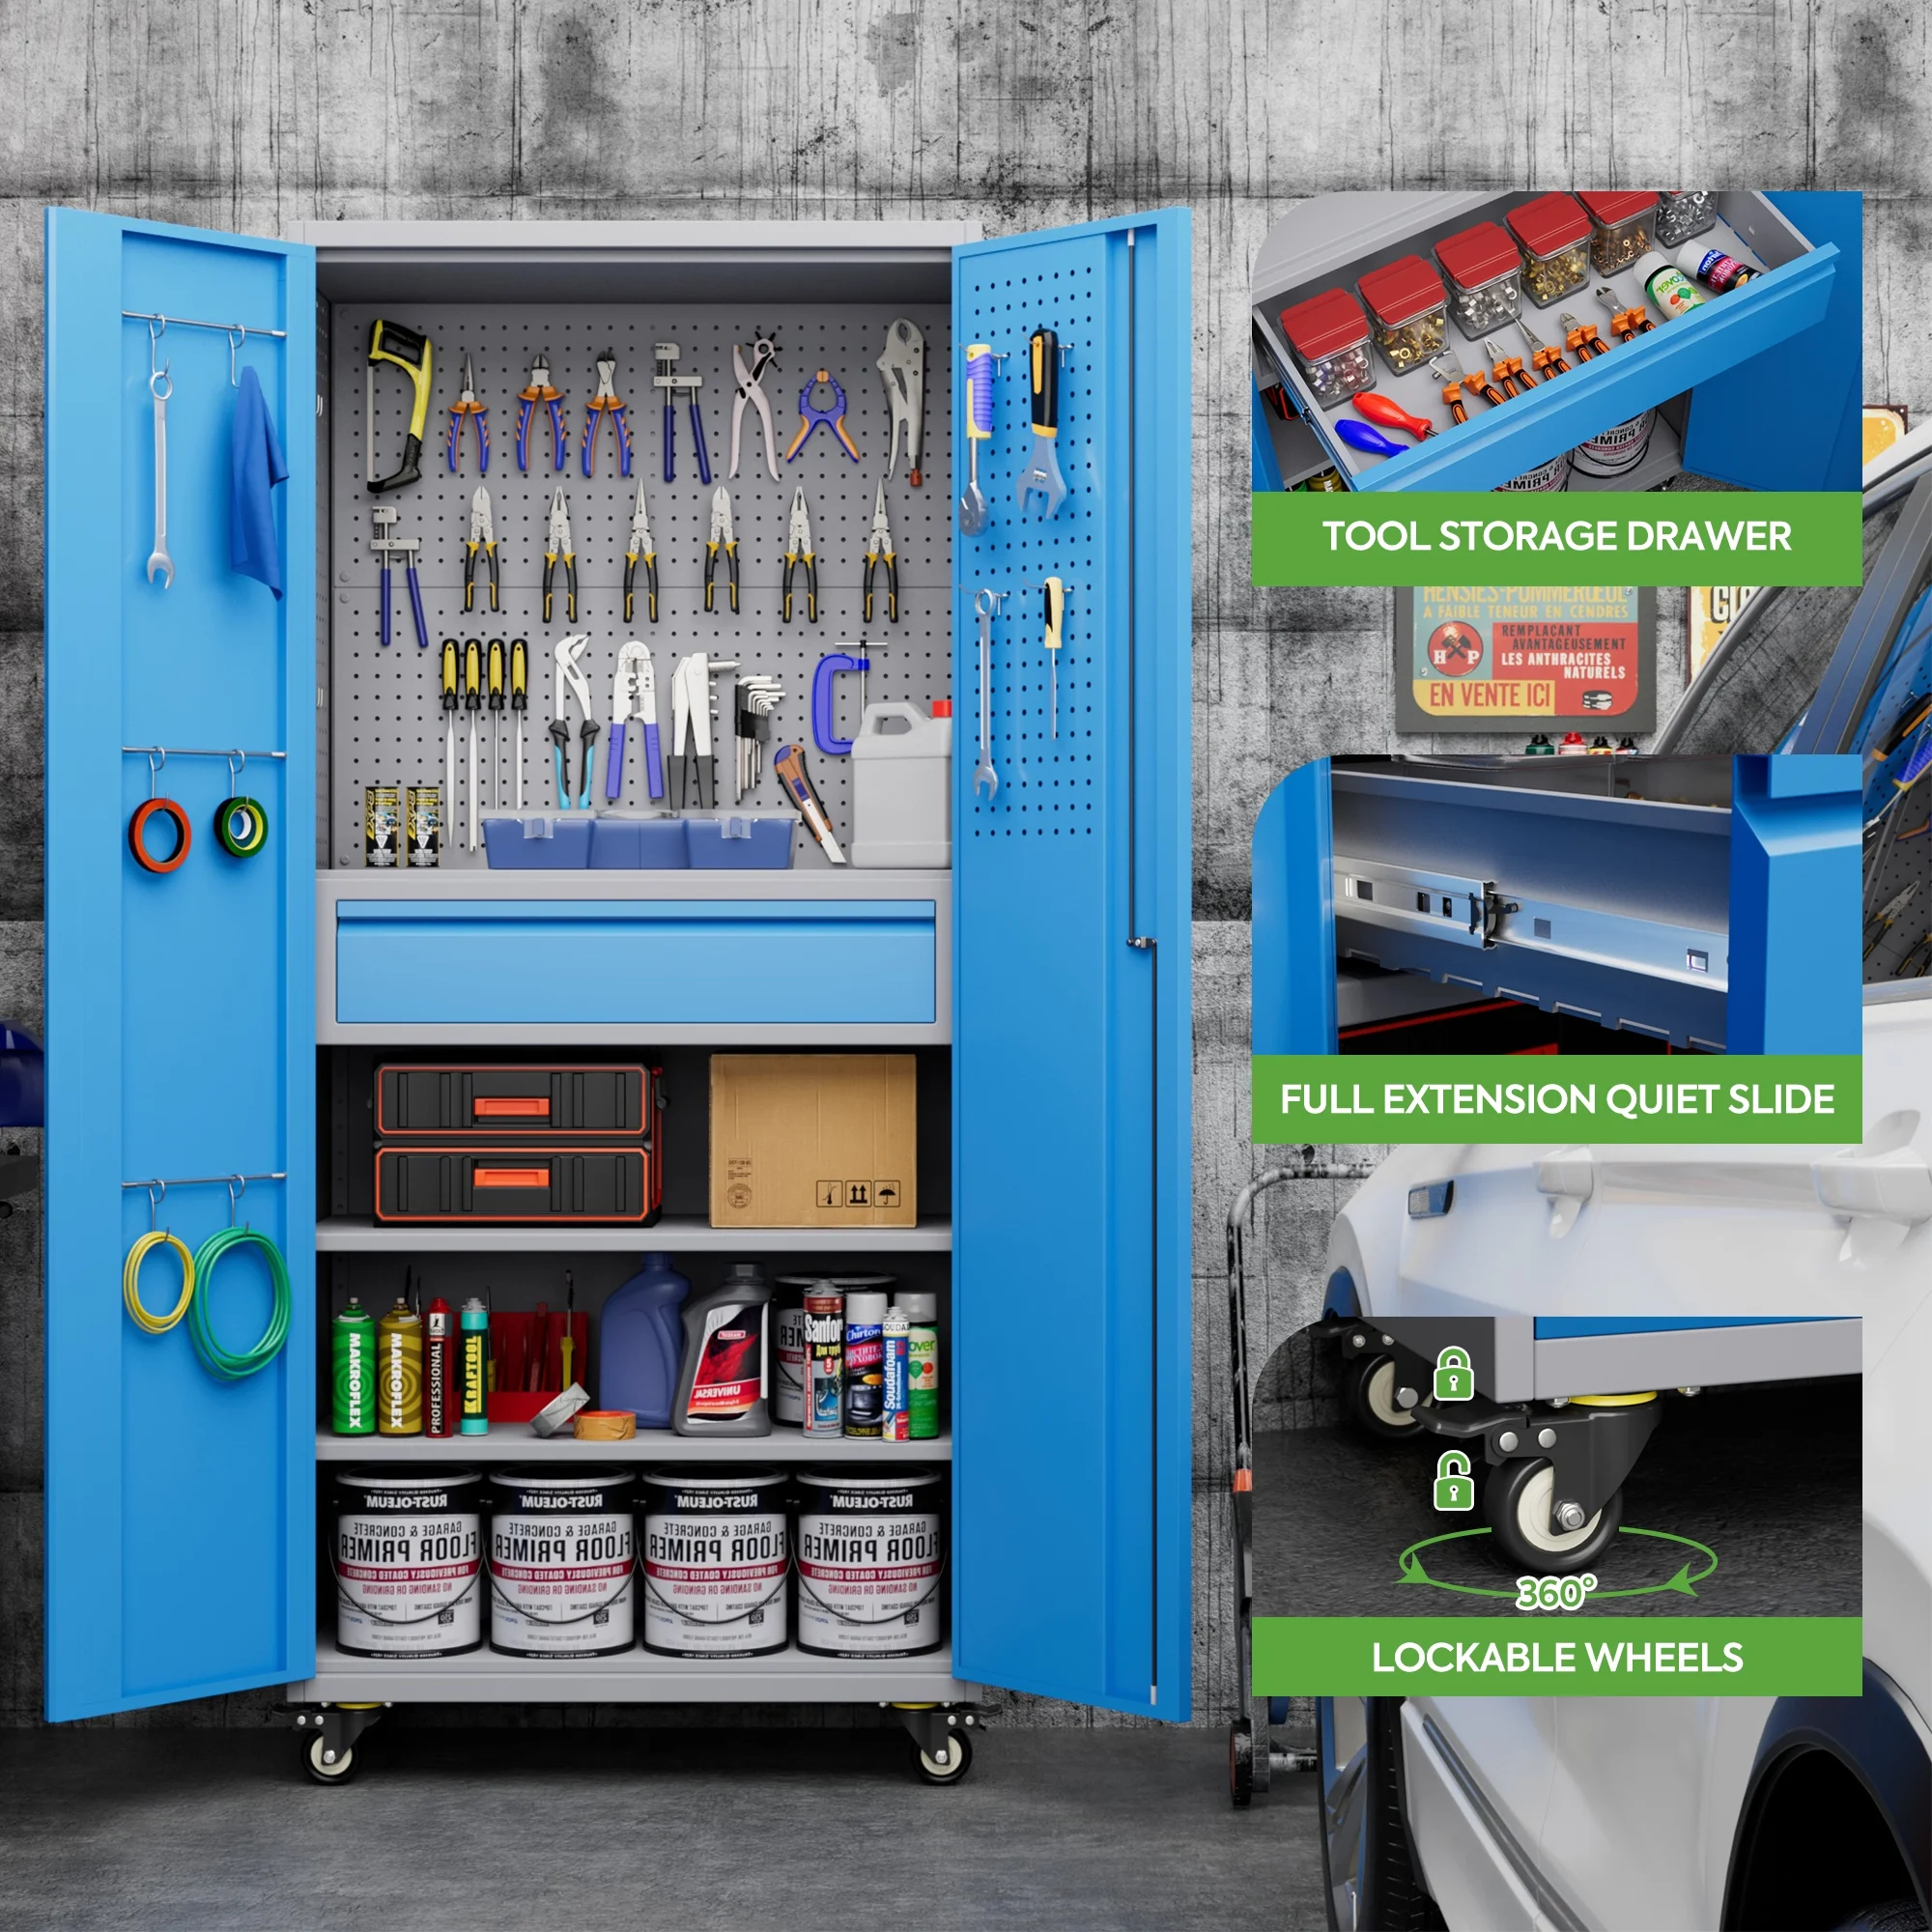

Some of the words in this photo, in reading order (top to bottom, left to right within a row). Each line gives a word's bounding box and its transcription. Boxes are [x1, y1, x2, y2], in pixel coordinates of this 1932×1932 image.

[1423, 606, 1433, 618] A
[1437, 606, 1480, 618] FAIBLE
[1489, 606, 1538, 618] TENEUR
[1547, 606, 1562, 618] EN
[1570, 606, 1629, 618] CENDRES
[1513, 639, 1626, 650] AVANTAGEUSEMENT
[1434, 650, 1447, 665] H
[1467, 650, 1480, 665] P
[1501, 653, 1522, 666] LES
[1528, 653, 1610, 666] ANTHRACITES
[1564, 667, 1626, 679] NATURELS
[1430, 683, 1454, 707] EN
[1461, 683, 1520, 707] VENTE
[1527, 683, 1550, 707] ICI
[805, 1314, 843, 1343] Sanfor
[846, 1326, 882, 1342] Chirton
[908, 1340, 936, 1351] over
[350, 1333, 360, 1429] MAKROFLEX
[391, 1333, 402, 1429] MAKROFLEX
[464, 1336, 478, 1413] KRAFTOOL
[884, 1340, 895, 1409] Soudafoam
[431, 1343, 441, 1434] PROFESSIONAL
